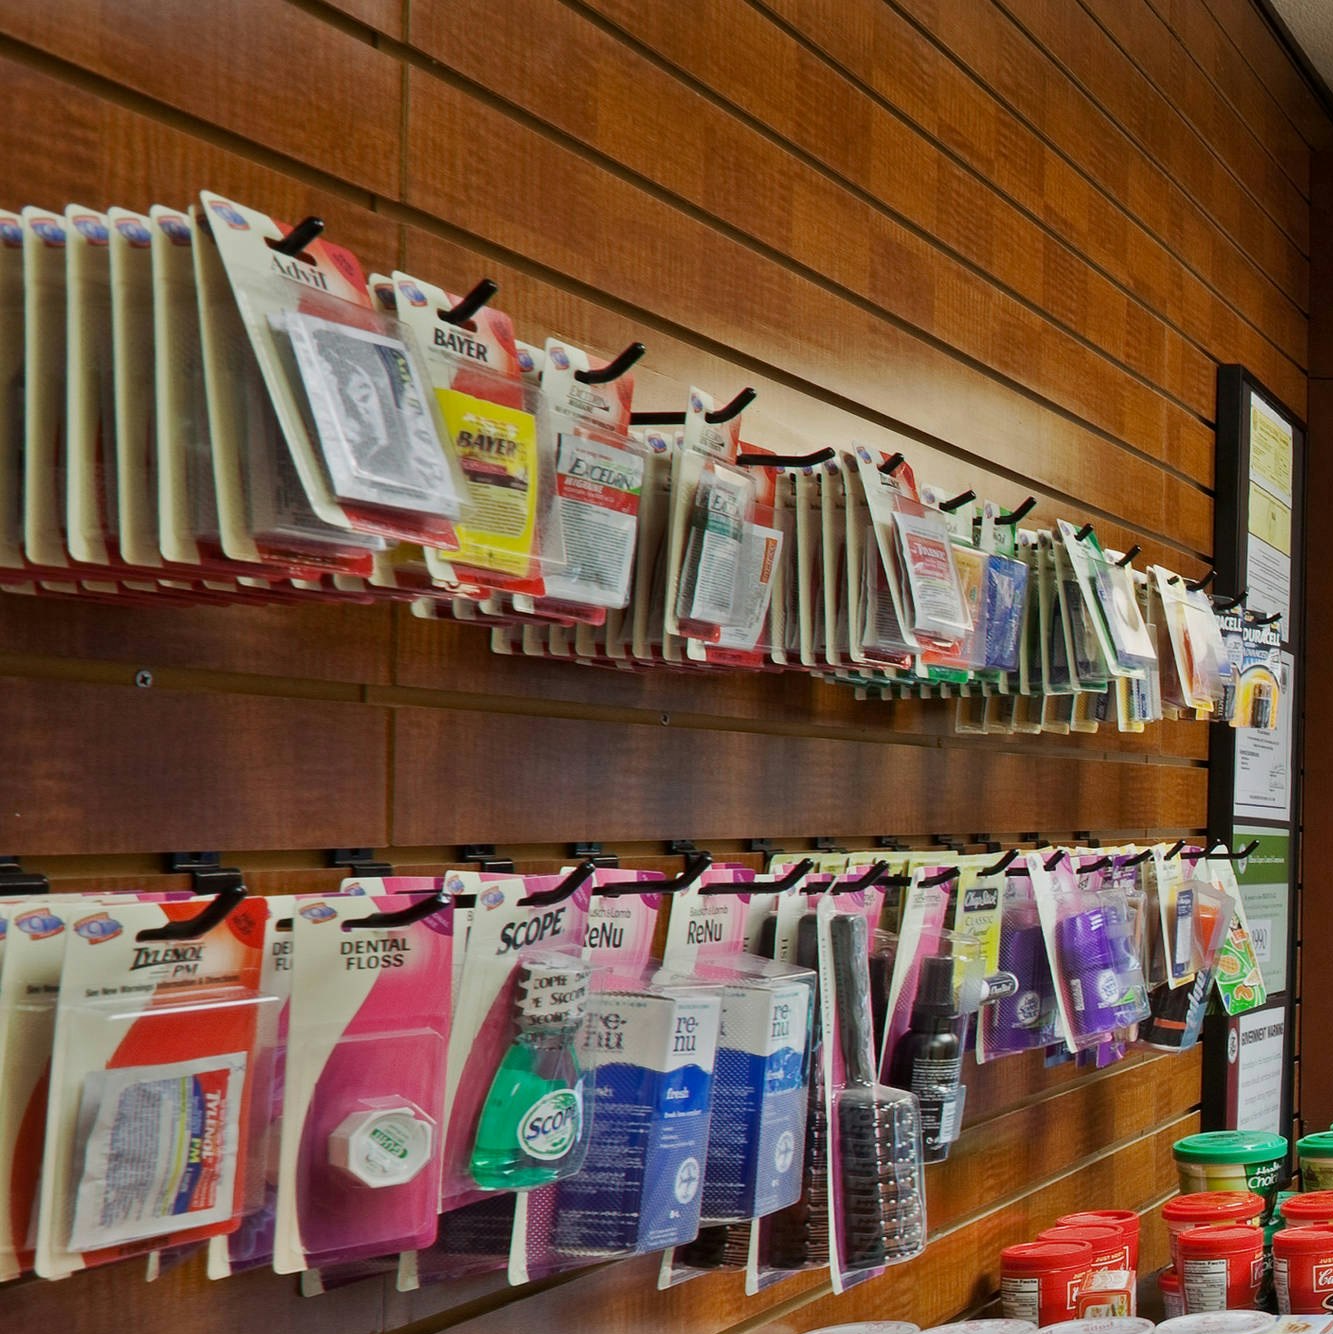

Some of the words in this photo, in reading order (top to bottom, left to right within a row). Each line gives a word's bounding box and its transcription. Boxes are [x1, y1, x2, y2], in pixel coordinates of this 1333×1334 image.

[434, 328, 488, 363] BAYER
[456, 430, 518, 459] BAYER
[1242, 627, 1281, 647] DURACELL
[496, 906, 567, 955] SCOPE
[687, 919, 723, 945] ReNu
[340, 938, 411, 955] DENTAL
[129, 945, 207, 972] TYLENOL
[346, 953, 405, 970] FLOSS
[172, 963, 199, 978] PM
[673, 1033, 697, 1052] nu
[1240, 1026, 1267, 1047] GOVERNMENT
